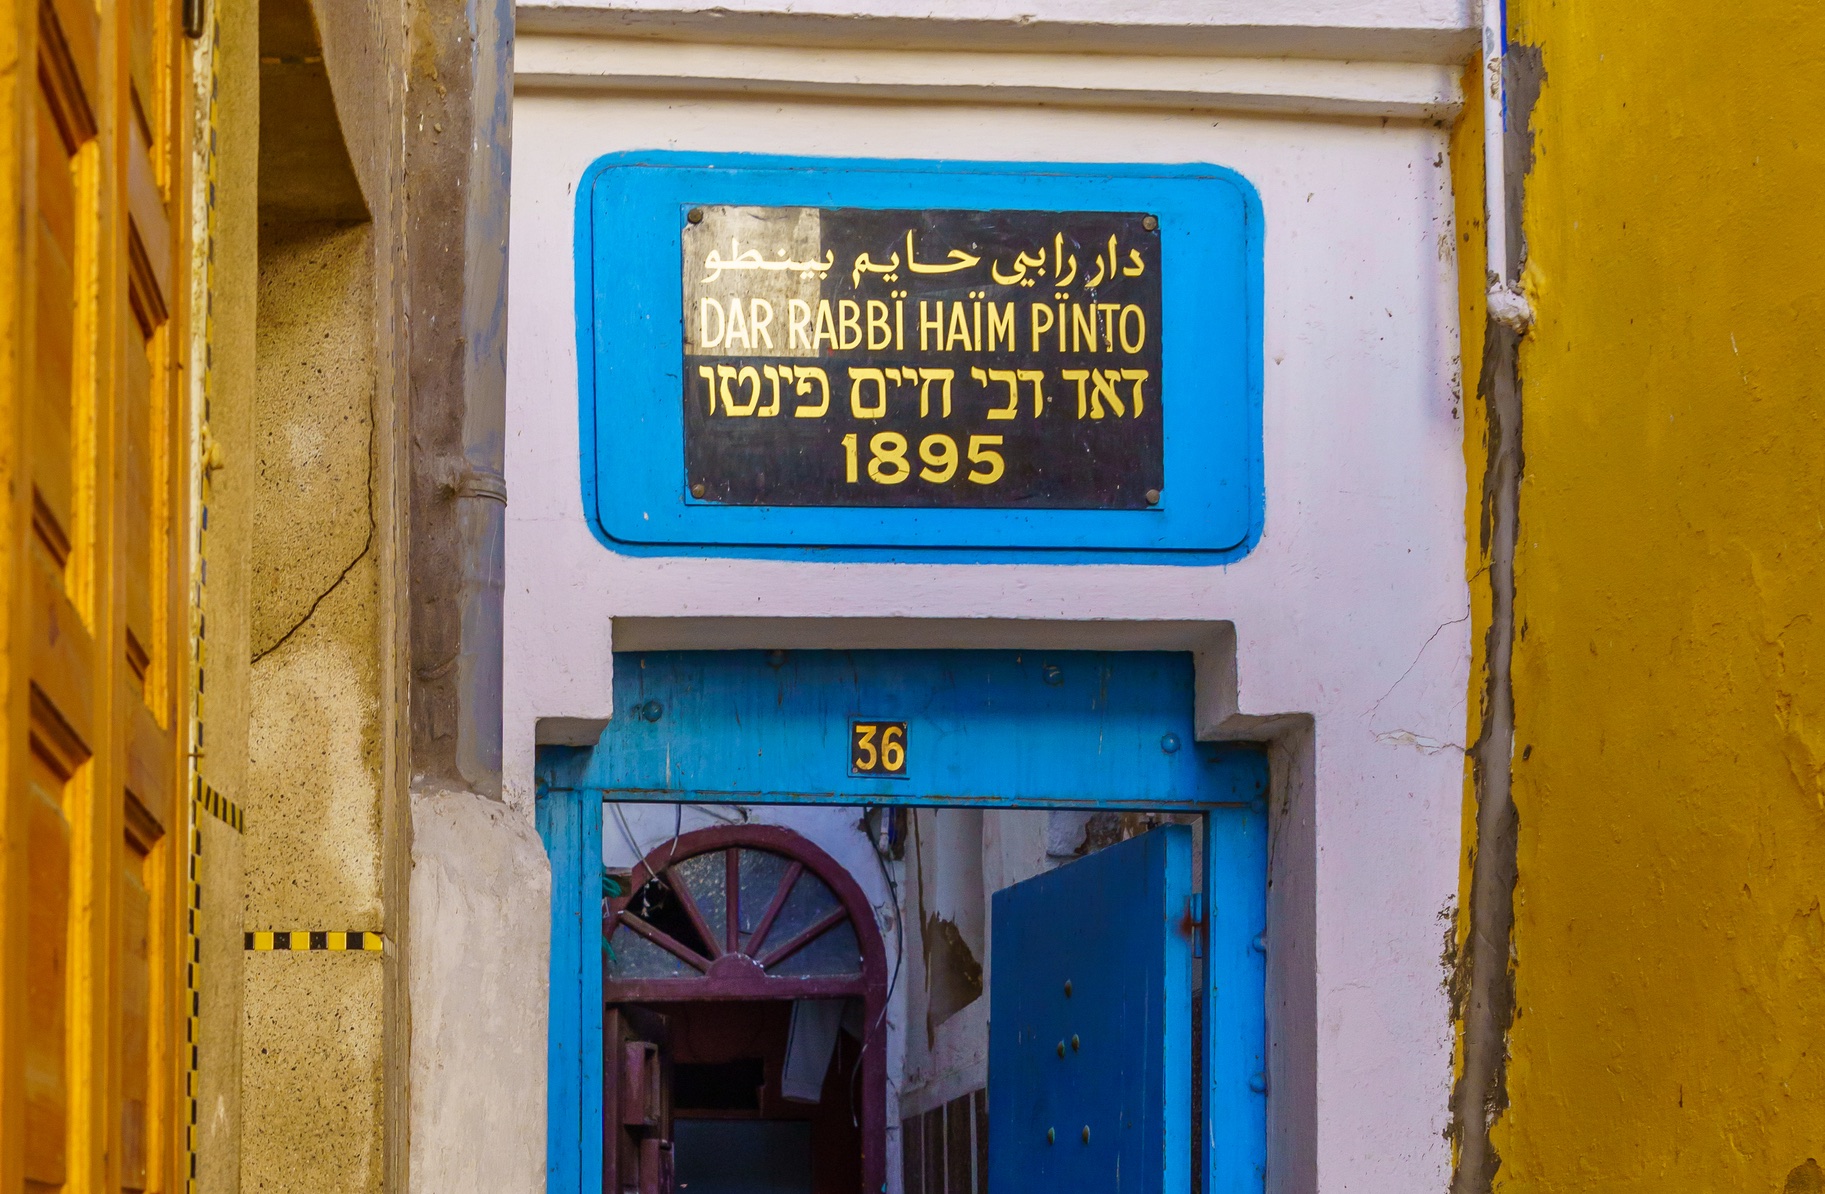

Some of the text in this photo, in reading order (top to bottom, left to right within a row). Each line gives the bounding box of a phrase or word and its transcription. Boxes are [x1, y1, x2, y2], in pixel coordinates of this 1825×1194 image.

[701, 237, 835, 283] بينطو
[852, 229, 981, 289] حايم
[1085, 233, 1145, 288] دار
[701, 290, 1146, 354] DAR RABBÏ HAÏM PÏNTO
[699, 364, 830, 418] פינטו
[848, 365, 955, 419] חיים
[841, 431, 1005, 485] 1895
[855, 725, 905, 771] 36
